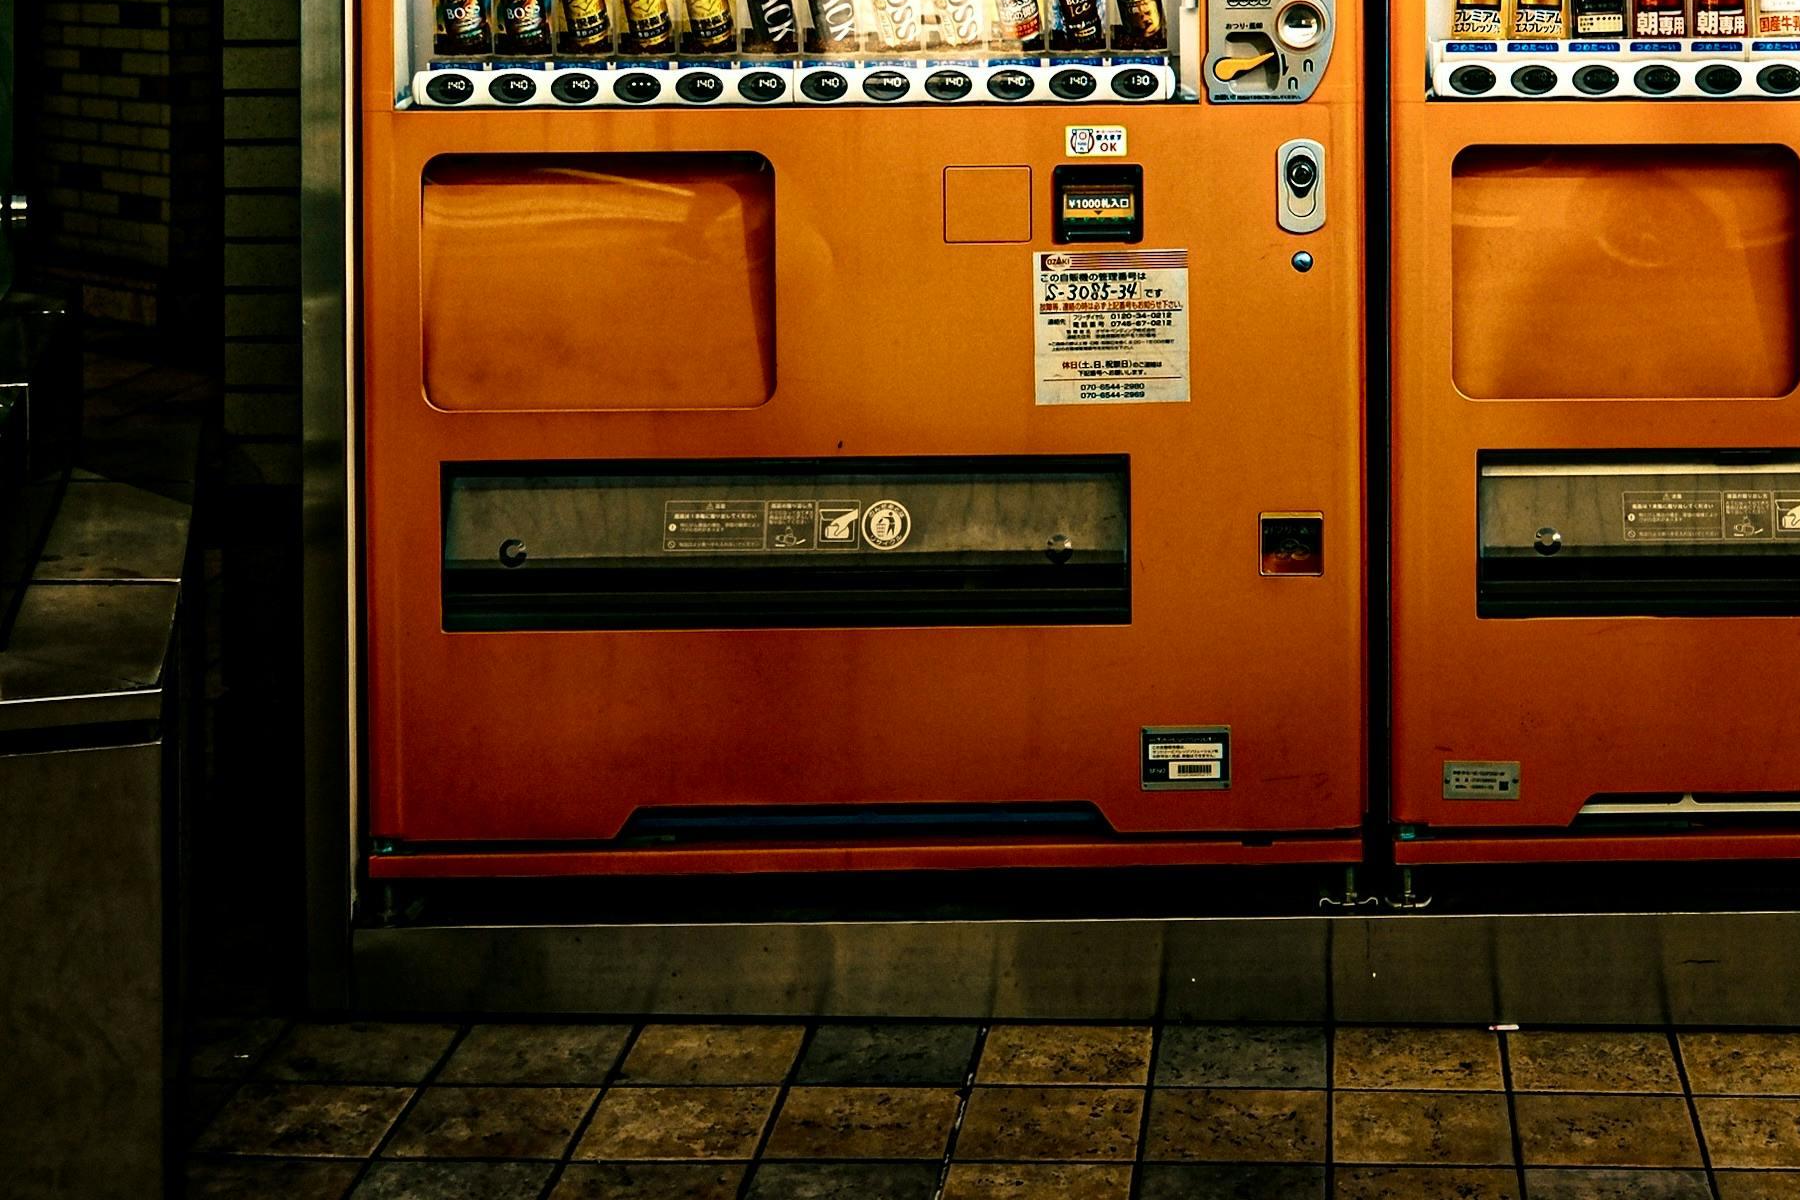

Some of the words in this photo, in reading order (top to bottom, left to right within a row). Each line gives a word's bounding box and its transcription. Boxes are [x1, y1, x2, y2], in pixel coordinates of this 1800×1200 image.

[446, 3, 481, 20] BOSS
[506, 3, 541, 20] BOSS
[1455, 11, 1500, 23] プレミアム
[1515, 11, 1562, 23] プレミアム
[1637, 13, 1685, 35] 朝専用
[1697, 11, 1745, 35] 朝専用
[1759, 15, 1800, 33] 国産牛乳
[1100, 142, 1118, 152] OK
[1069, 198, 1129, 208] ¥1000札入口
[1047, 257, 1070, 265] OZAKI
[1040, 272, 1147, 282] この自販機の管理番号は
[1144, 288, 1163, 297] です
